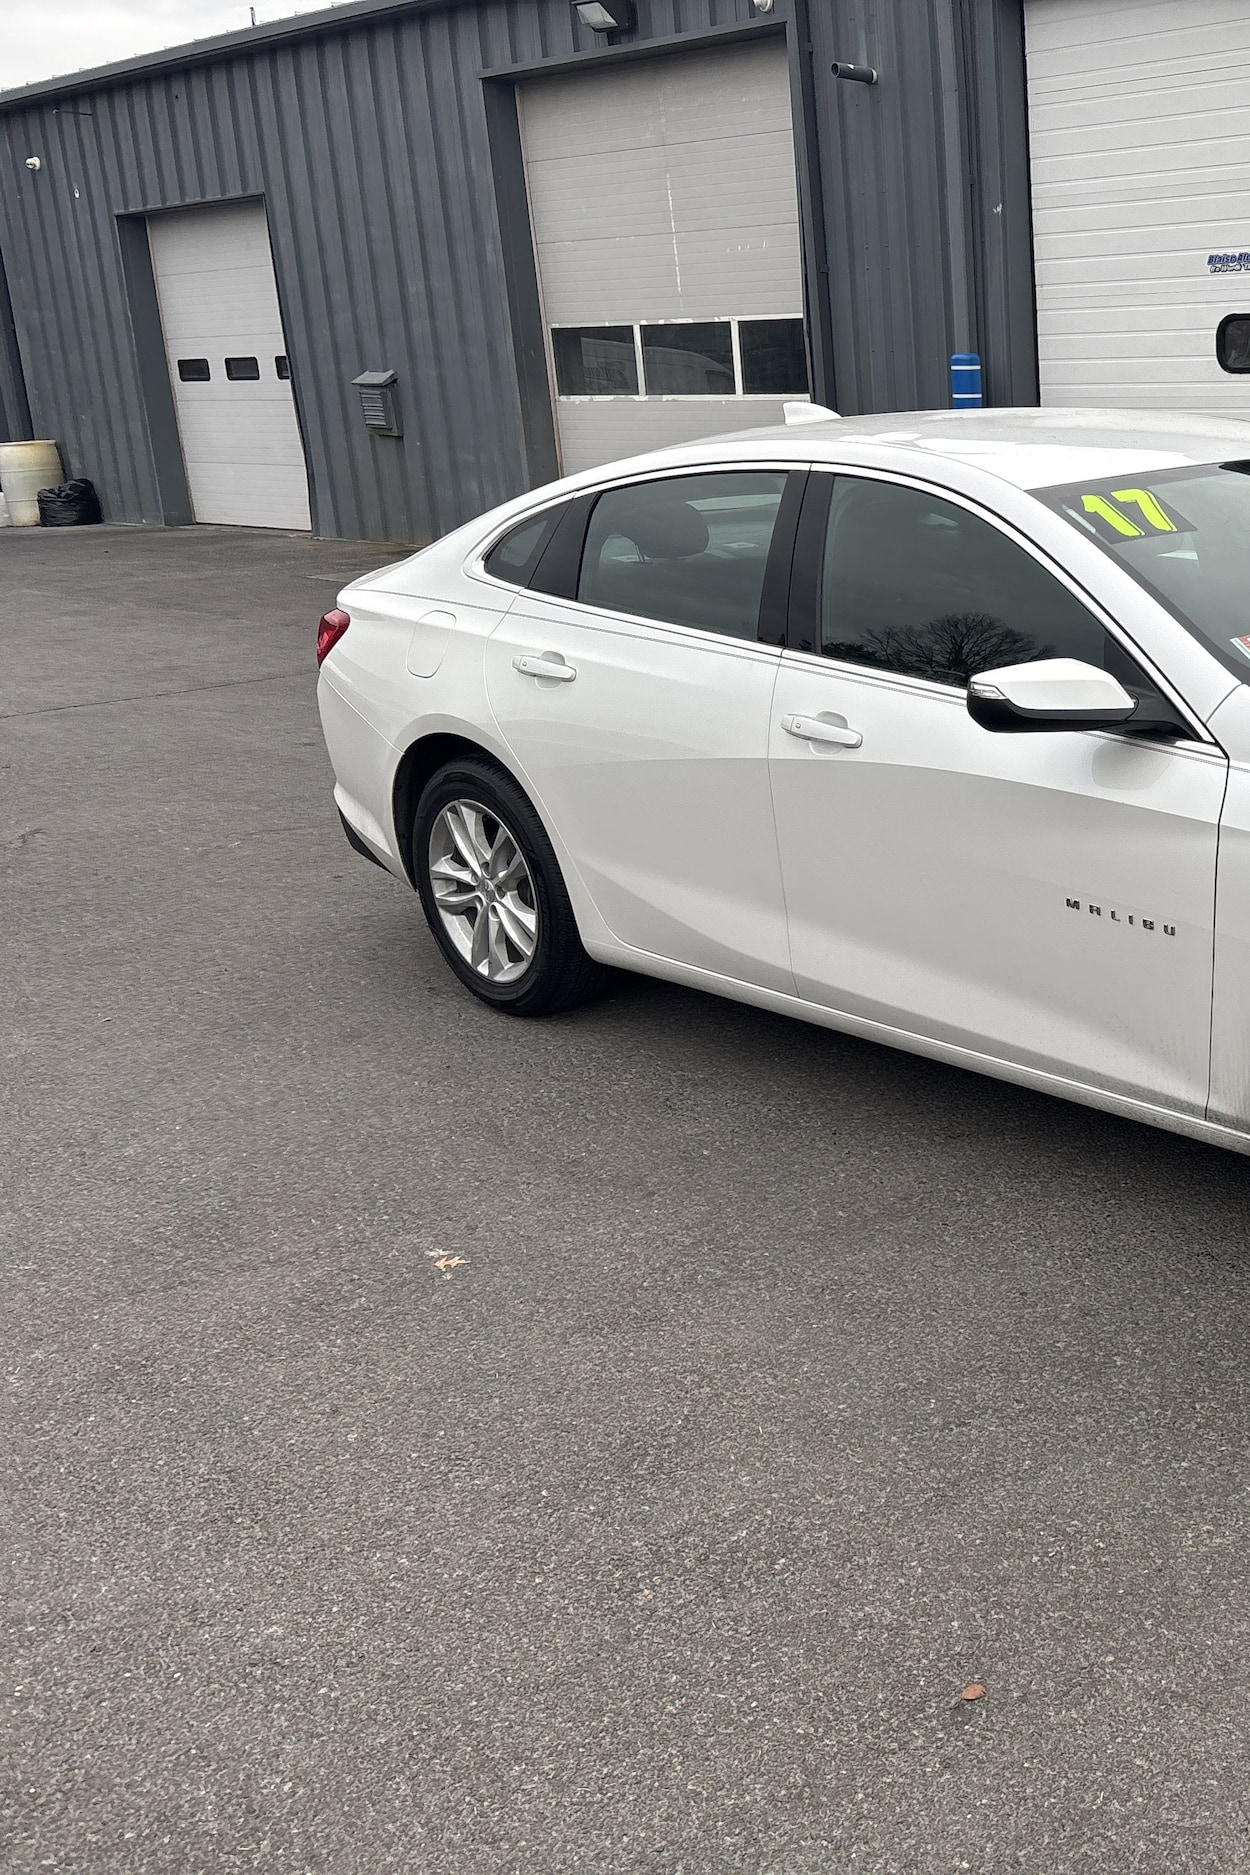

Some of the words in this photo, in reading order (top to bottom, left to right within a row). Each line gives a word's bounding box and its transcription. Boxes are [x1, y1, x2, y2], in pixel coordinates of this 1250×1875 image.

[1208, 254, 1237, 265] Blaise
[1080, 488, 1178, 537] 17
[1065, 897, 1176, 936] MALIBU
